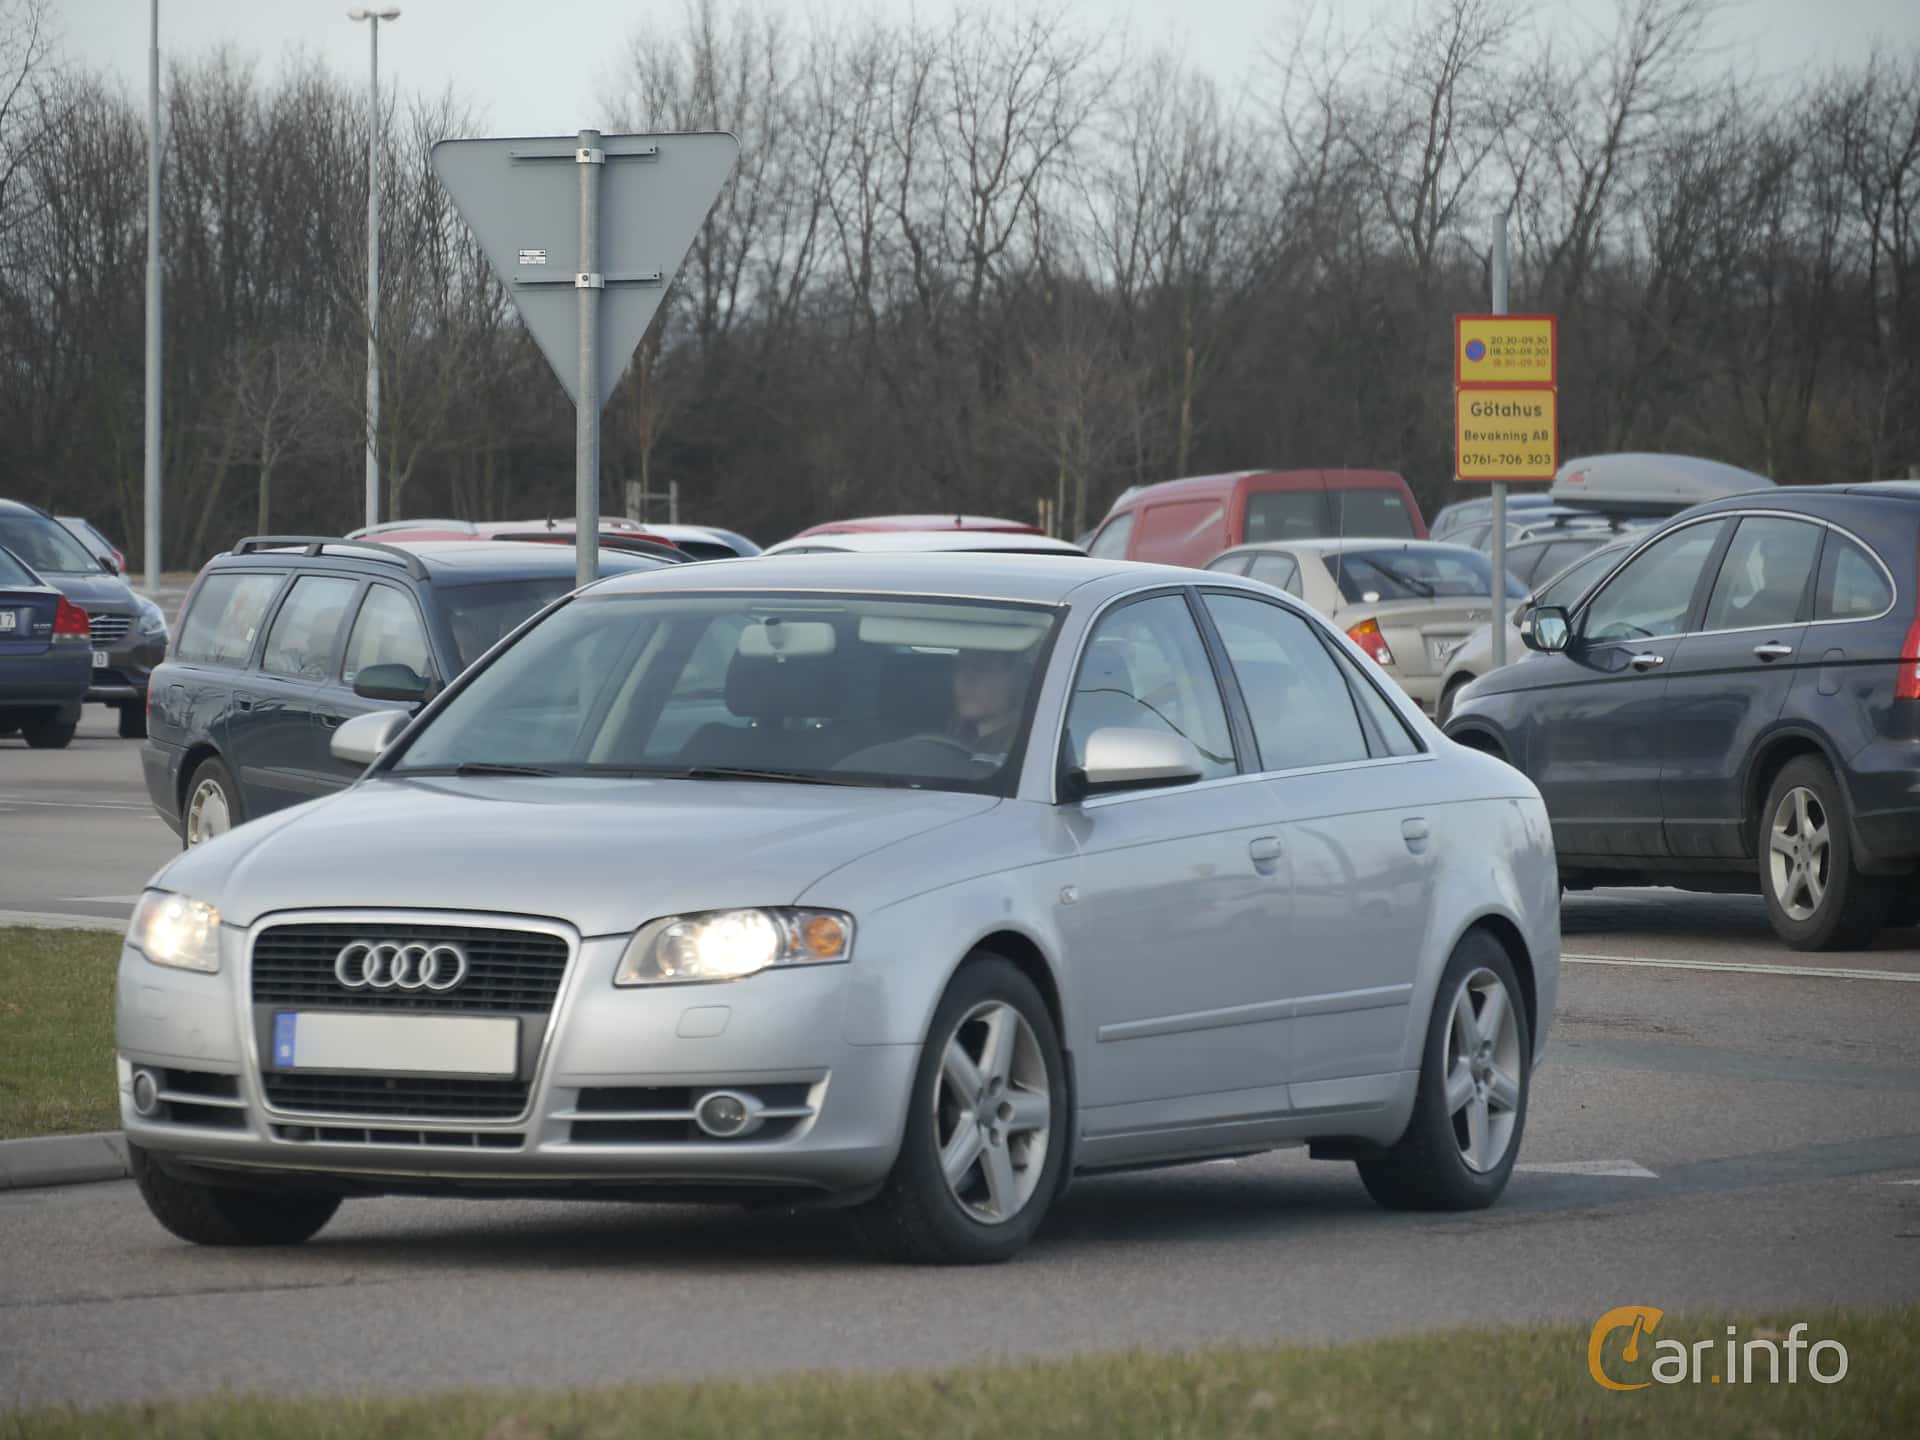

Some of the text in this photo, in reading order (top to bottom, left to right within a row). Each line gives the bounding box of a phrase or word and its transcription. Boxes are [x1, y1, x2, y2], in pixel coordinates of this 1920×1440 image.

[1471, 401, 1543, 417] Götahus
[1464, 430, 1549, 445] Bevakning AB
[1462, 454, 1551, 465] 0761-706 303
